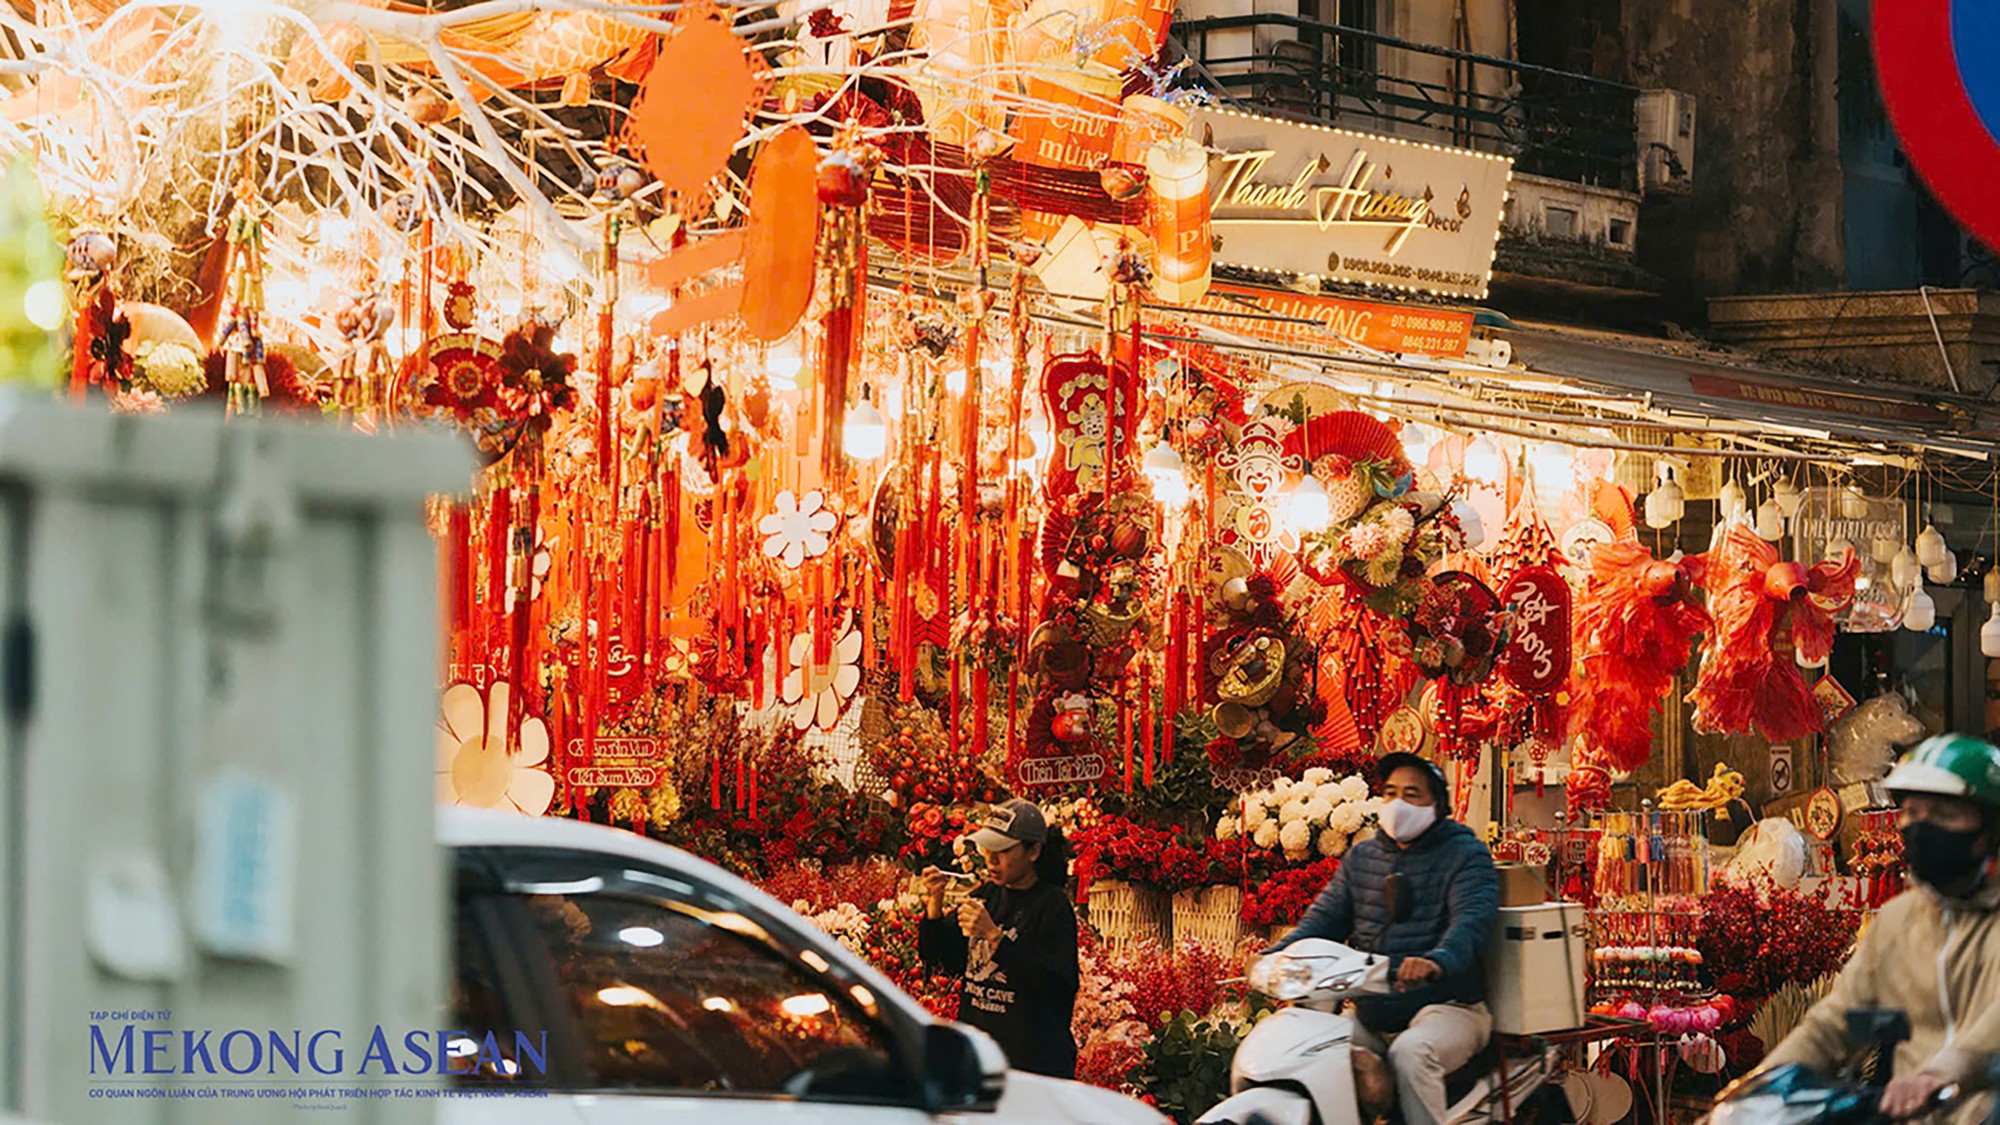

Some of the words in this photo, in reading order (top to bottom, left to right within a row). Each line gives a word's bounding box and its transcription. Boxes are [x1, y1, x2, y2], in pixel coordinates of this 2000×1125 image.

[1211, 150, 1320, 212] Thanh
[1426, 208, 1464, 233] Decor
[1515, 615, 1553, 679] 2025
